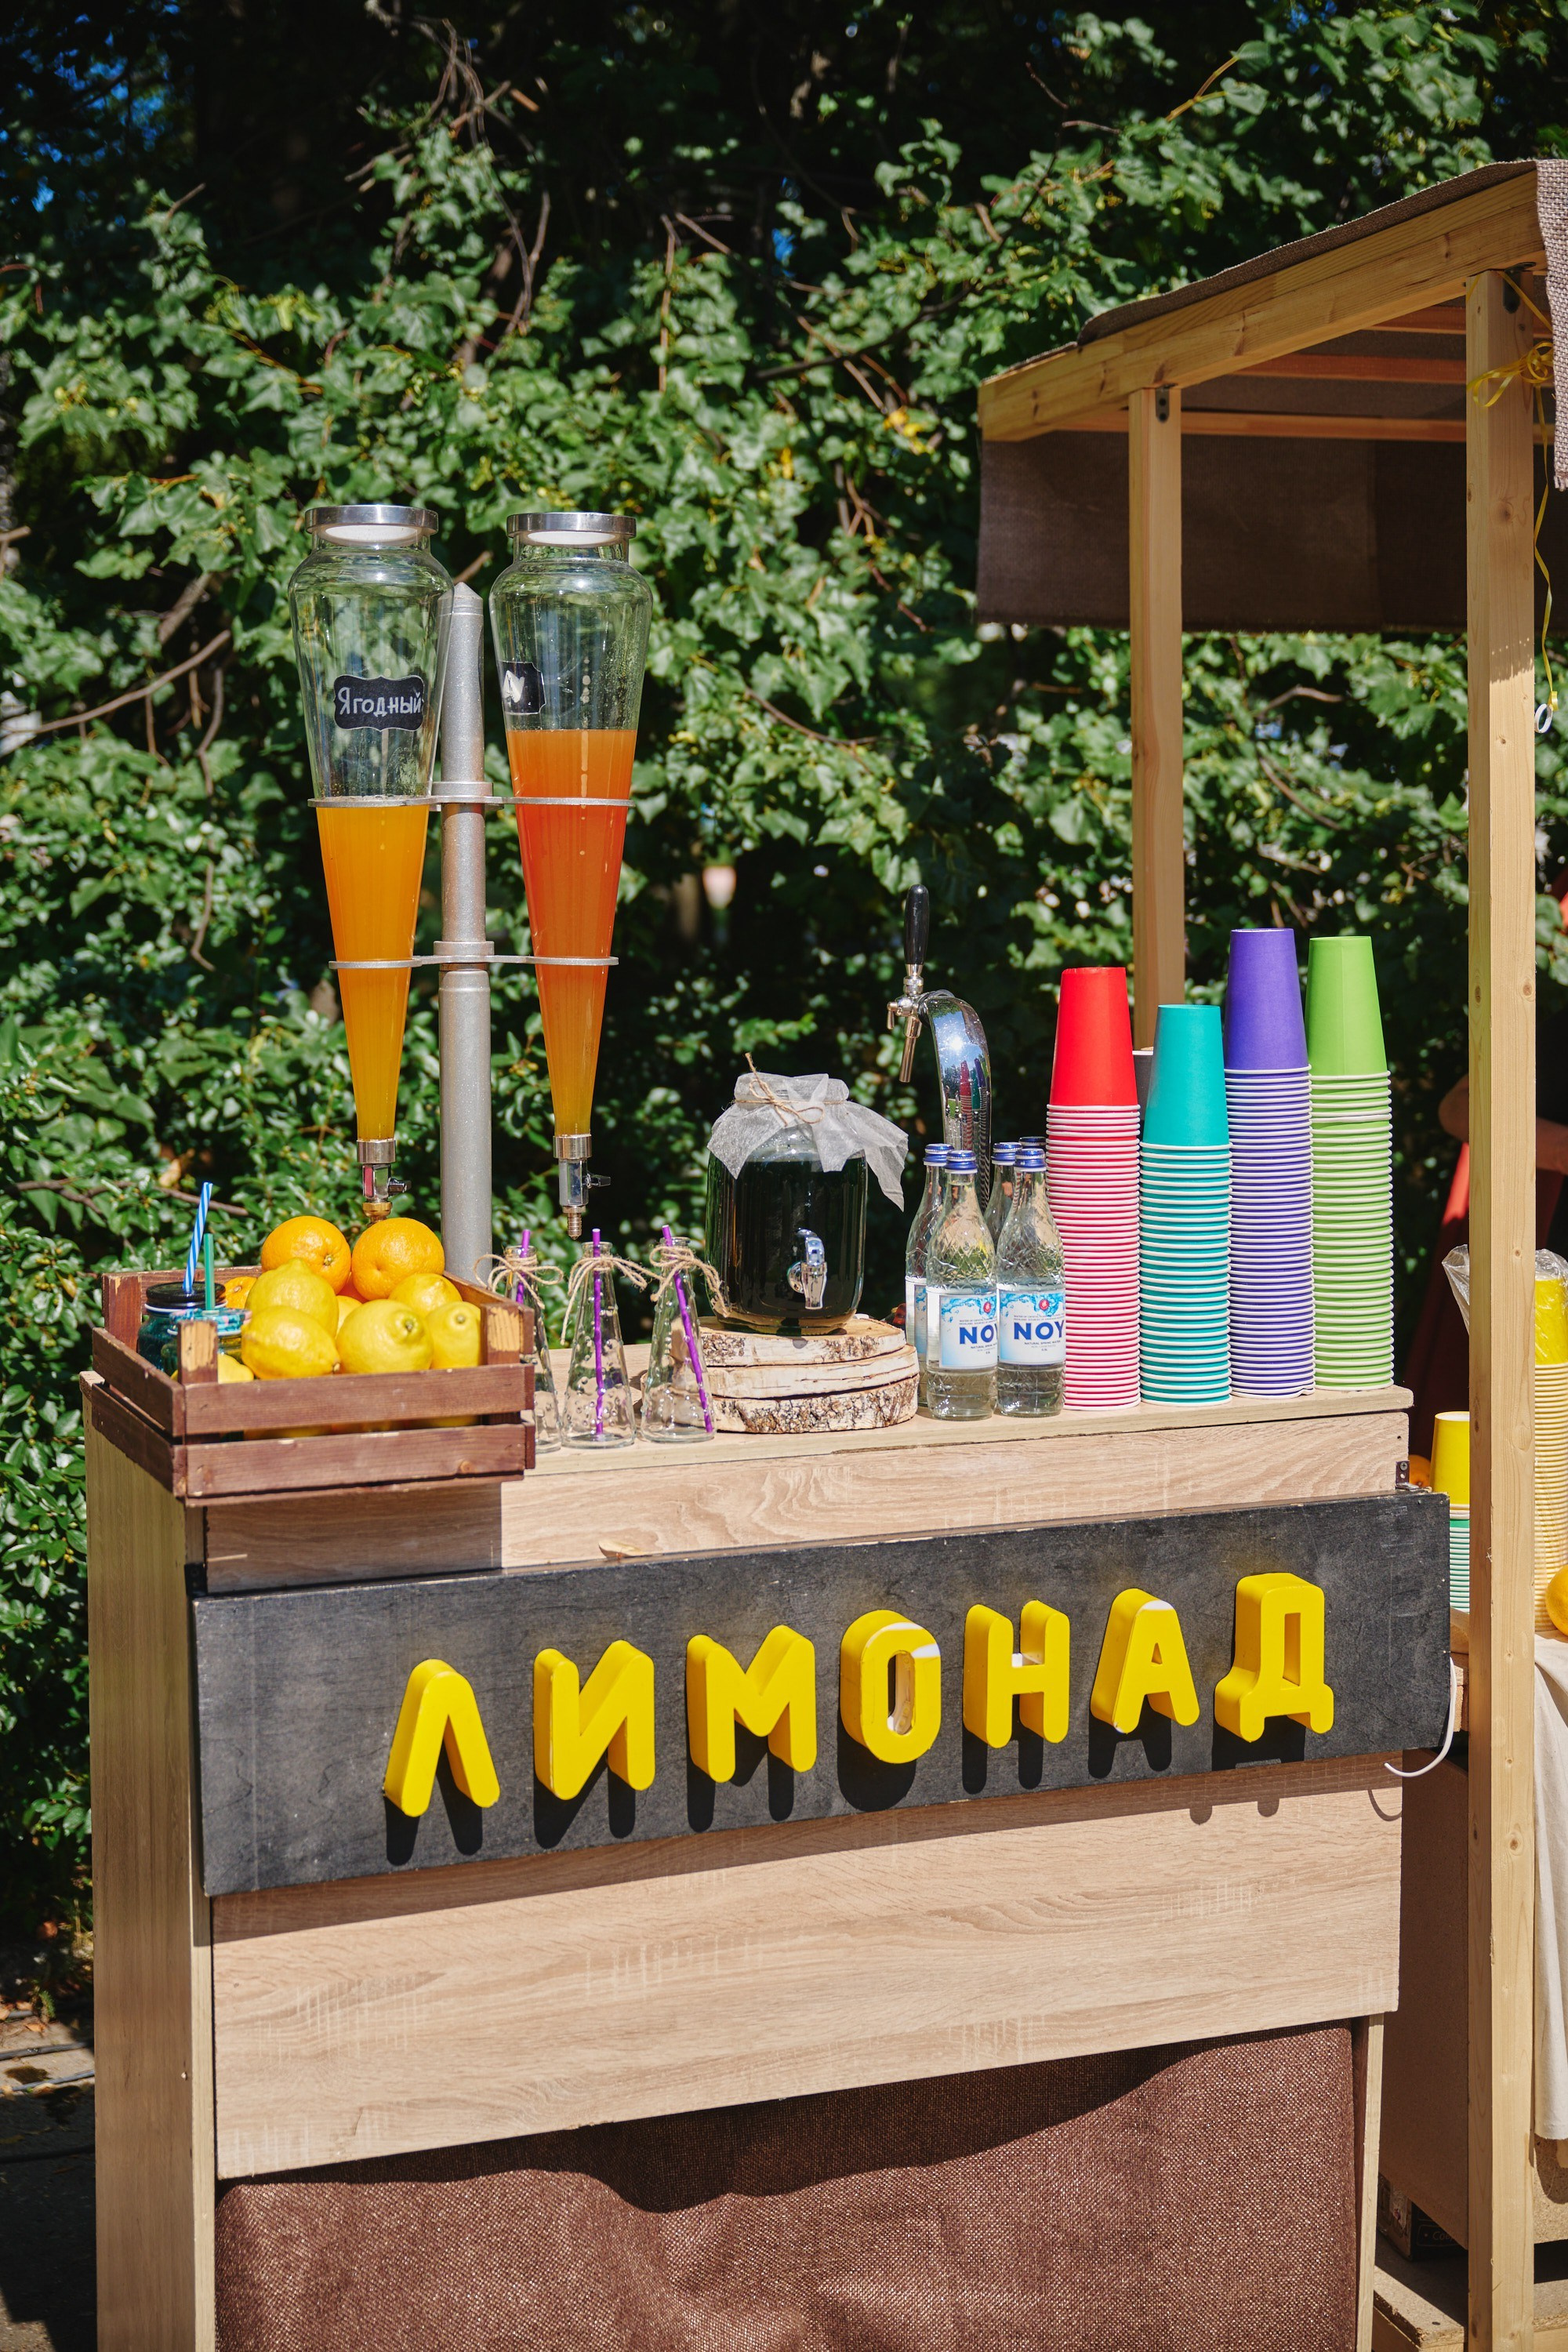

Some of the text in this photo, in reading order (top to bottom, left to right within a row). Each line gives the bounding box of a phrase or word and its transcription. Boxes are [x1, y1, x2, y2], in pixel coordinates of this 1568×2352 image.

[337, 686, 422, 717] Ягодный
[1014, 1319, 1065, 1340] NOY
[383, 1572, 1335, 1818] ЛИМОНАД
